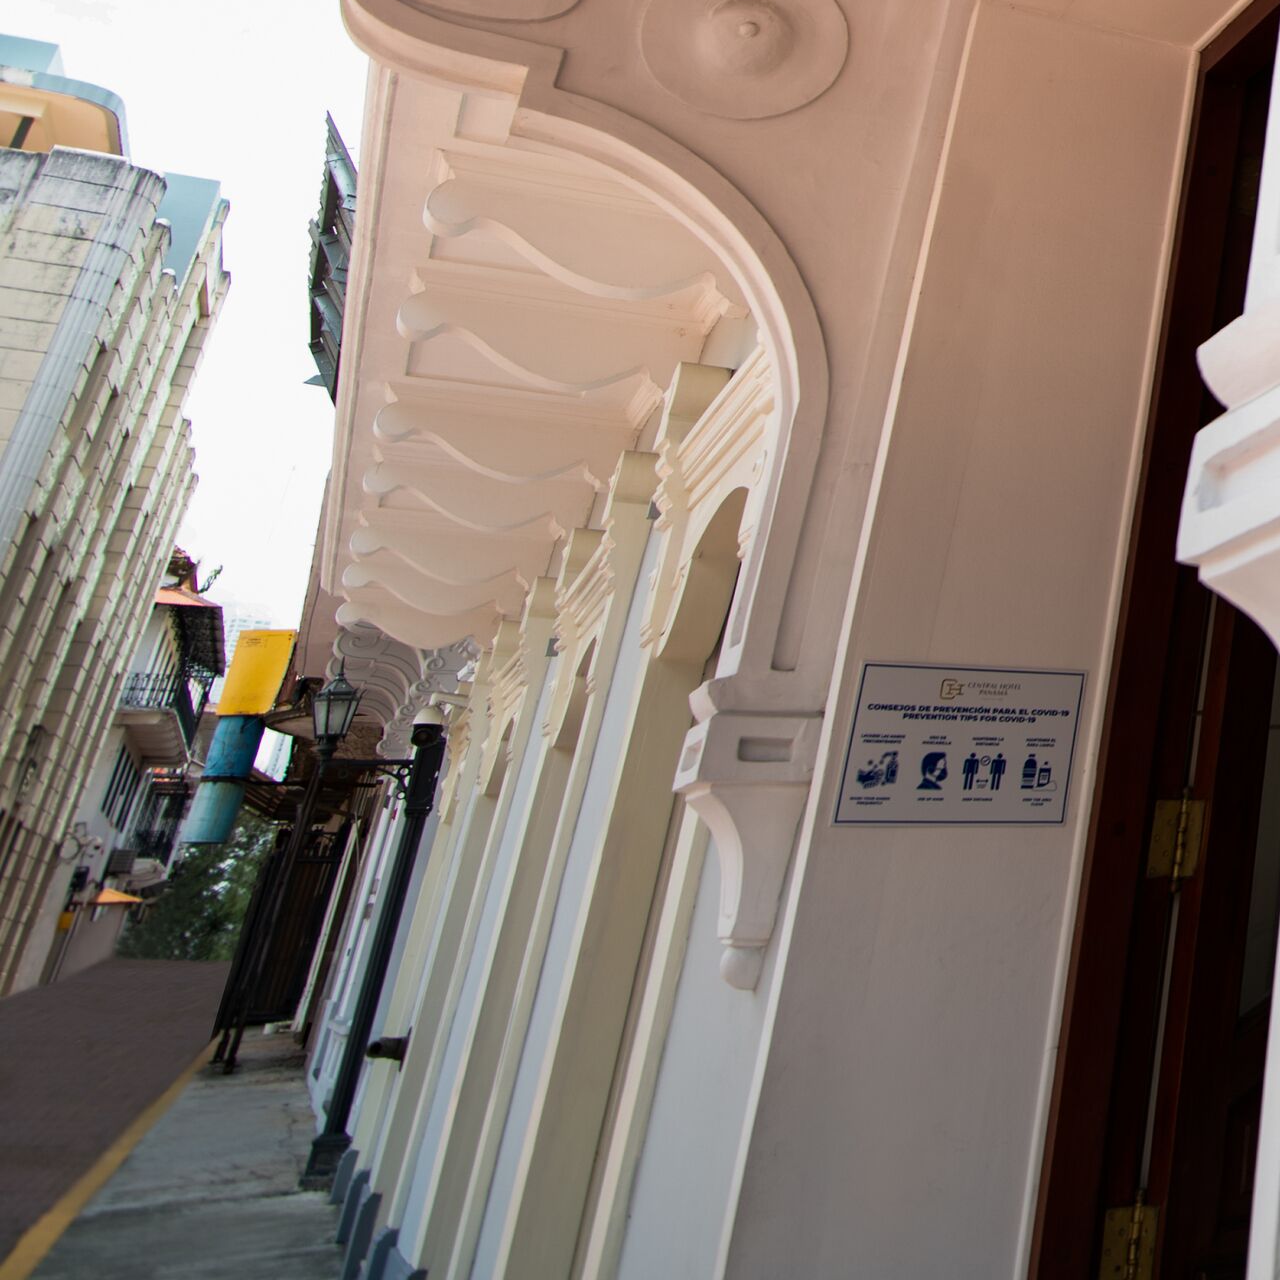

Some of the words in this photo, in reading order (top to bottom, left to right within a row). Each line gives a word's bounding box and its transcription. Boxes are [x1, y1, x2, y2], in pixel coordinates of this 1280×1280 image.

[867, 703, 917, 713] CONSEJOS
[918, 705, 931, 713] DE
[992, 708, 1017, 716] PARA
[1018, 709, 1030, 717] EL
[1032, 709, 1070, 718] COVID-19
[902, 713, 959, 722] PREVENTION
[959, 714, 978, 722] TIPS
[979, 715, 997, 723] FOR
[999, 715, 1037, 724] COVID-19
